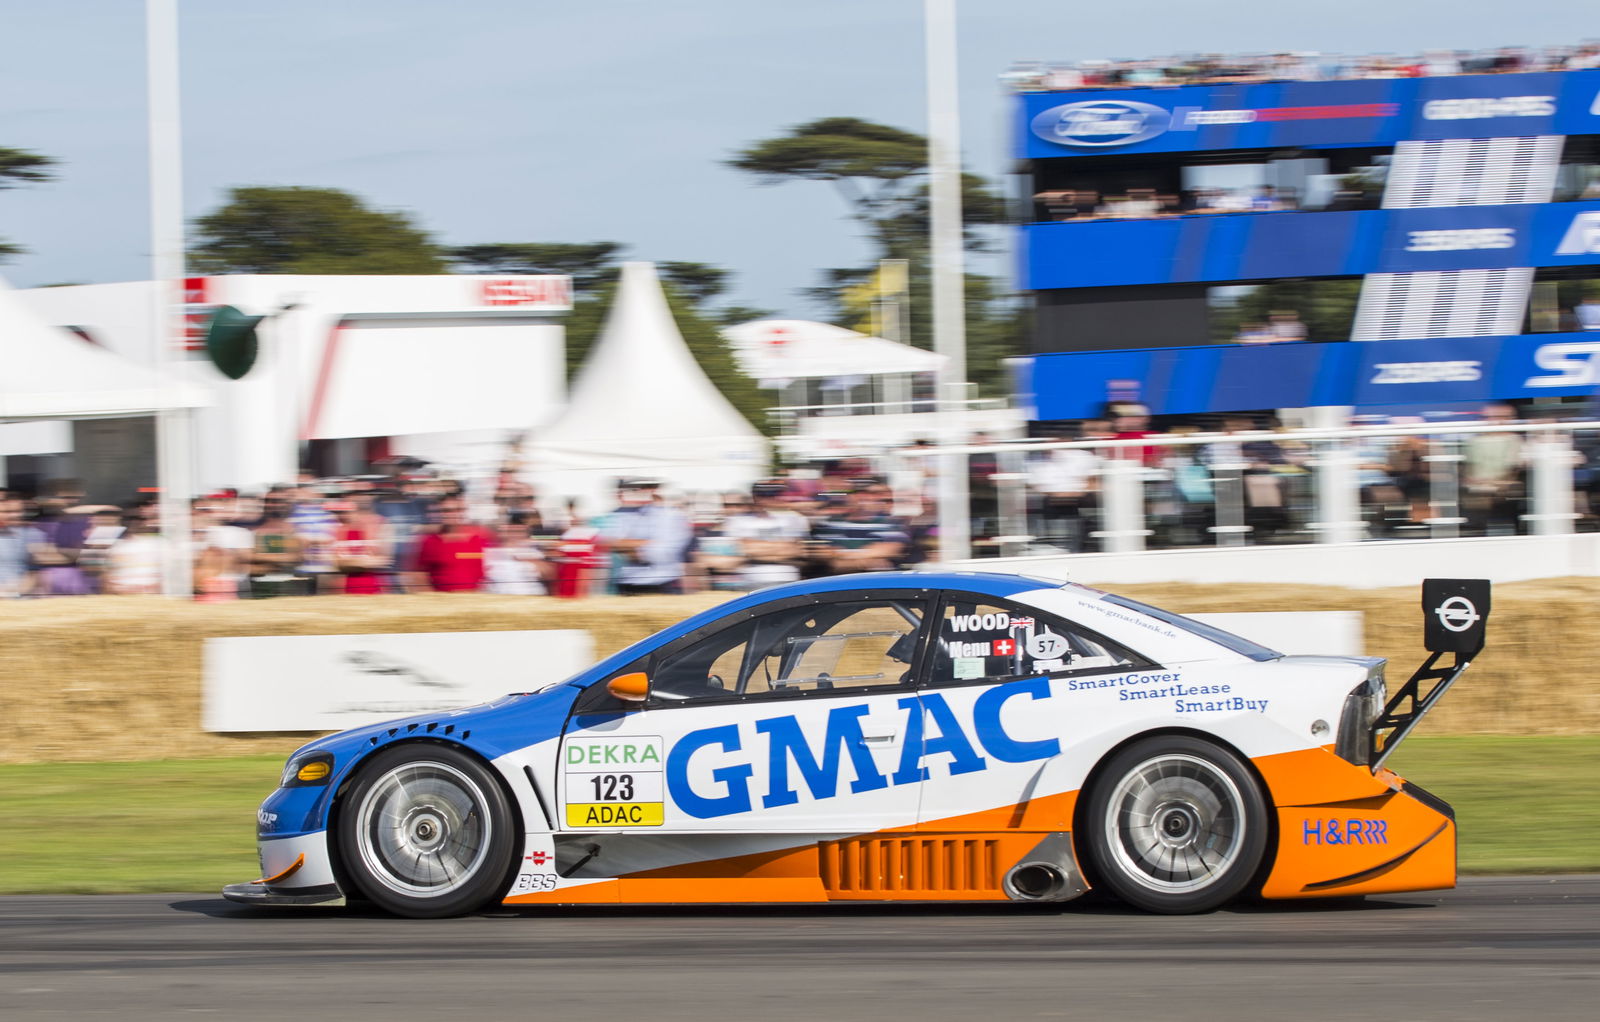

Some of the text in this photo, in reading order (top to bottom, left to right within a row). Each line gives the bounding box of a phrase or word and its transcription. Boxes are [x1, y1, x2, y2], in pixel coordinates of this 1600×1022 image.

[950, 613, 1010, 632] WOOD
[949, 640, 991, 658] Menu
[1038, 640, 1055, 653] 57
[1068, 673, 1181, 691] SmartCover
[1119, 684, 1231, 701] SmartLease
[1175, 697, 1269, 713] SmartBuy
[567, 744, 660, 764] DEKRA
[666, 677, 1061, 819] GMAC
[590, 774, 634, 801] 123
[586, 805, 642, 823] ADAC
[518, 873, 558, 890] BBS
